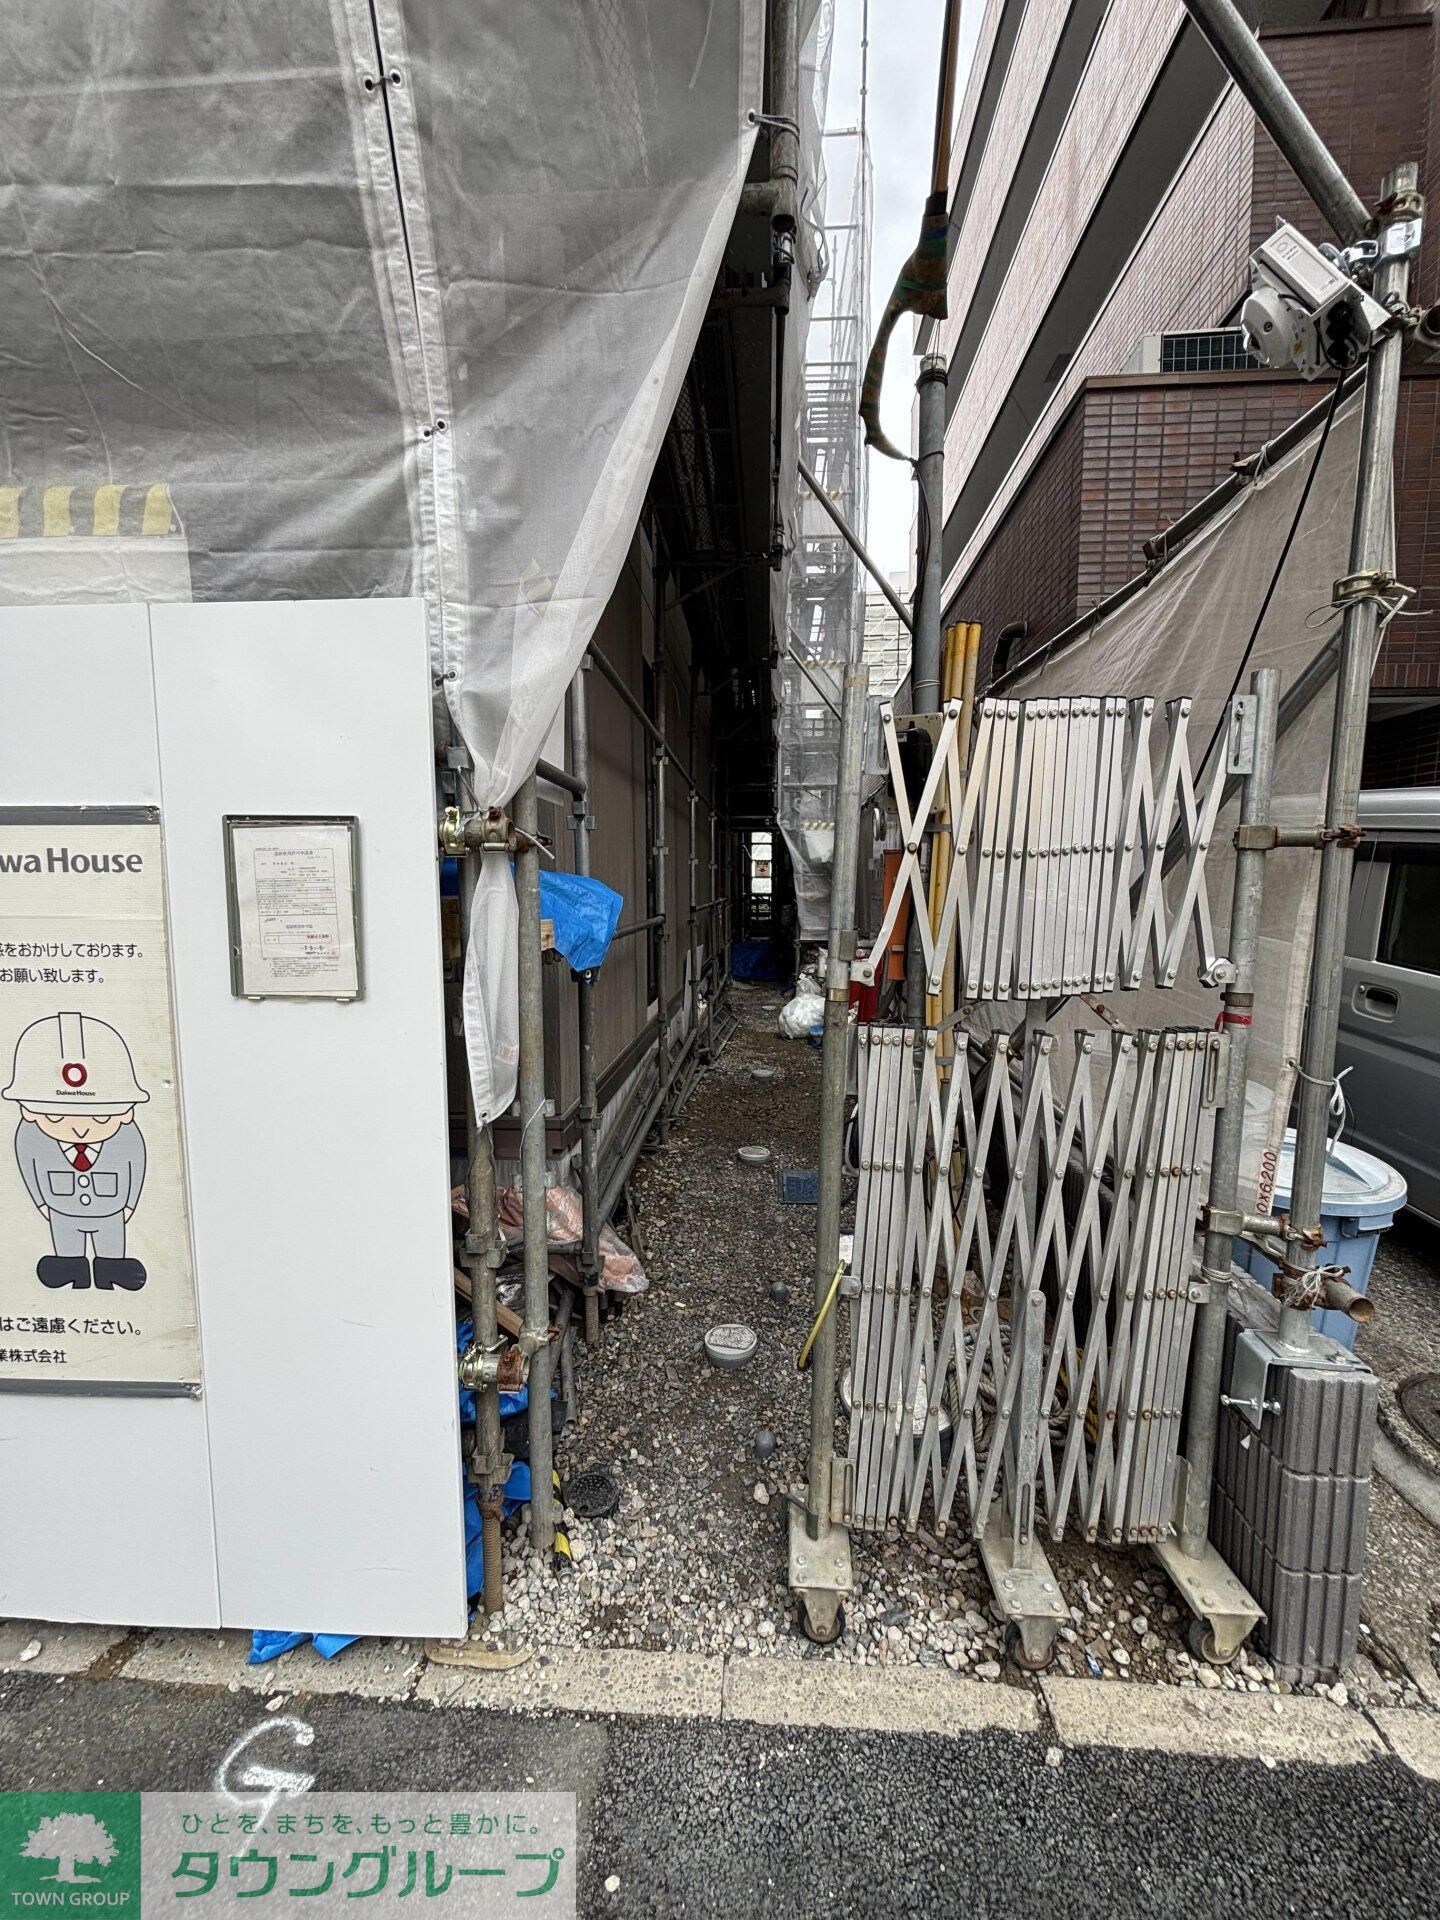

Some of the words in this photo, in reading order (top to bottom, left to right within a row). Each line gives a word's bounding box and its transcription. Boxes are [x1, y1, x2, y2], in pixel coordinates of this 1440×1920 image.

[0, 854, 42, 873] wa
[46, 847, 143, 873] House
[0, 968, 104, 983] お願い致します。
[76, 1089, 96, 1097] House
[0, 1316, 141, 1336] はご遠慮ください。
